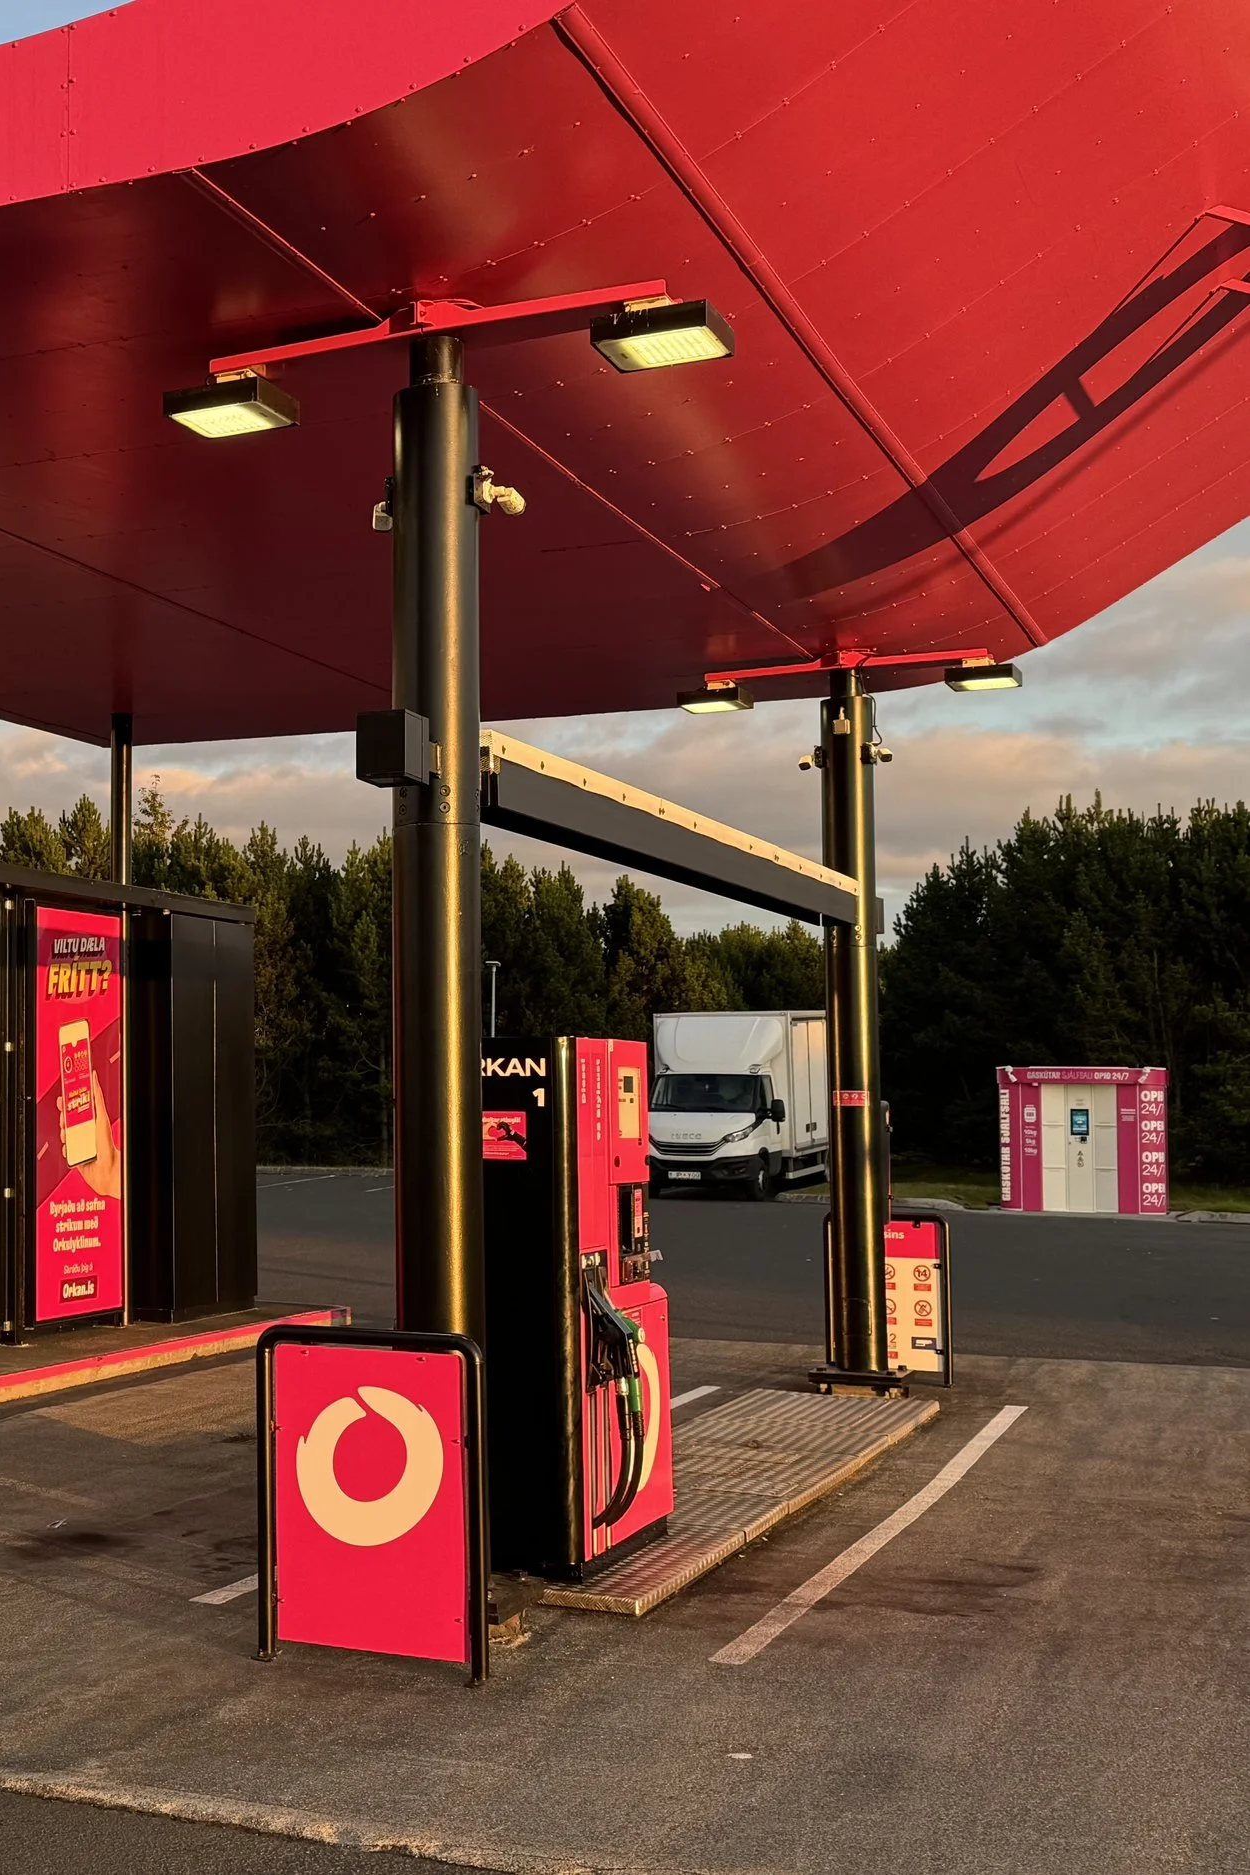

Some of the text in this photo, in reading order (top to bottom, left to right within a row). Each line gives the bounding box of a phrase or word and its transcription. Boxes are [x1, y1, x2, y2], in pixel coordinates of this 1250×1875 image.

[53, 937, 105, 954] VILTU DÆLA
[47, 955, 112, 995] FRÍTT?
[1112, 1072, 1129, 1081] 24/7
[532, 1087, 545, 1107] 1
[50, 1197, 106, 1218] Byrjaðu að safna
[55, 1215, 99, 1233] strikum með
[62, 1280, 95, 1299] Orkan.is
